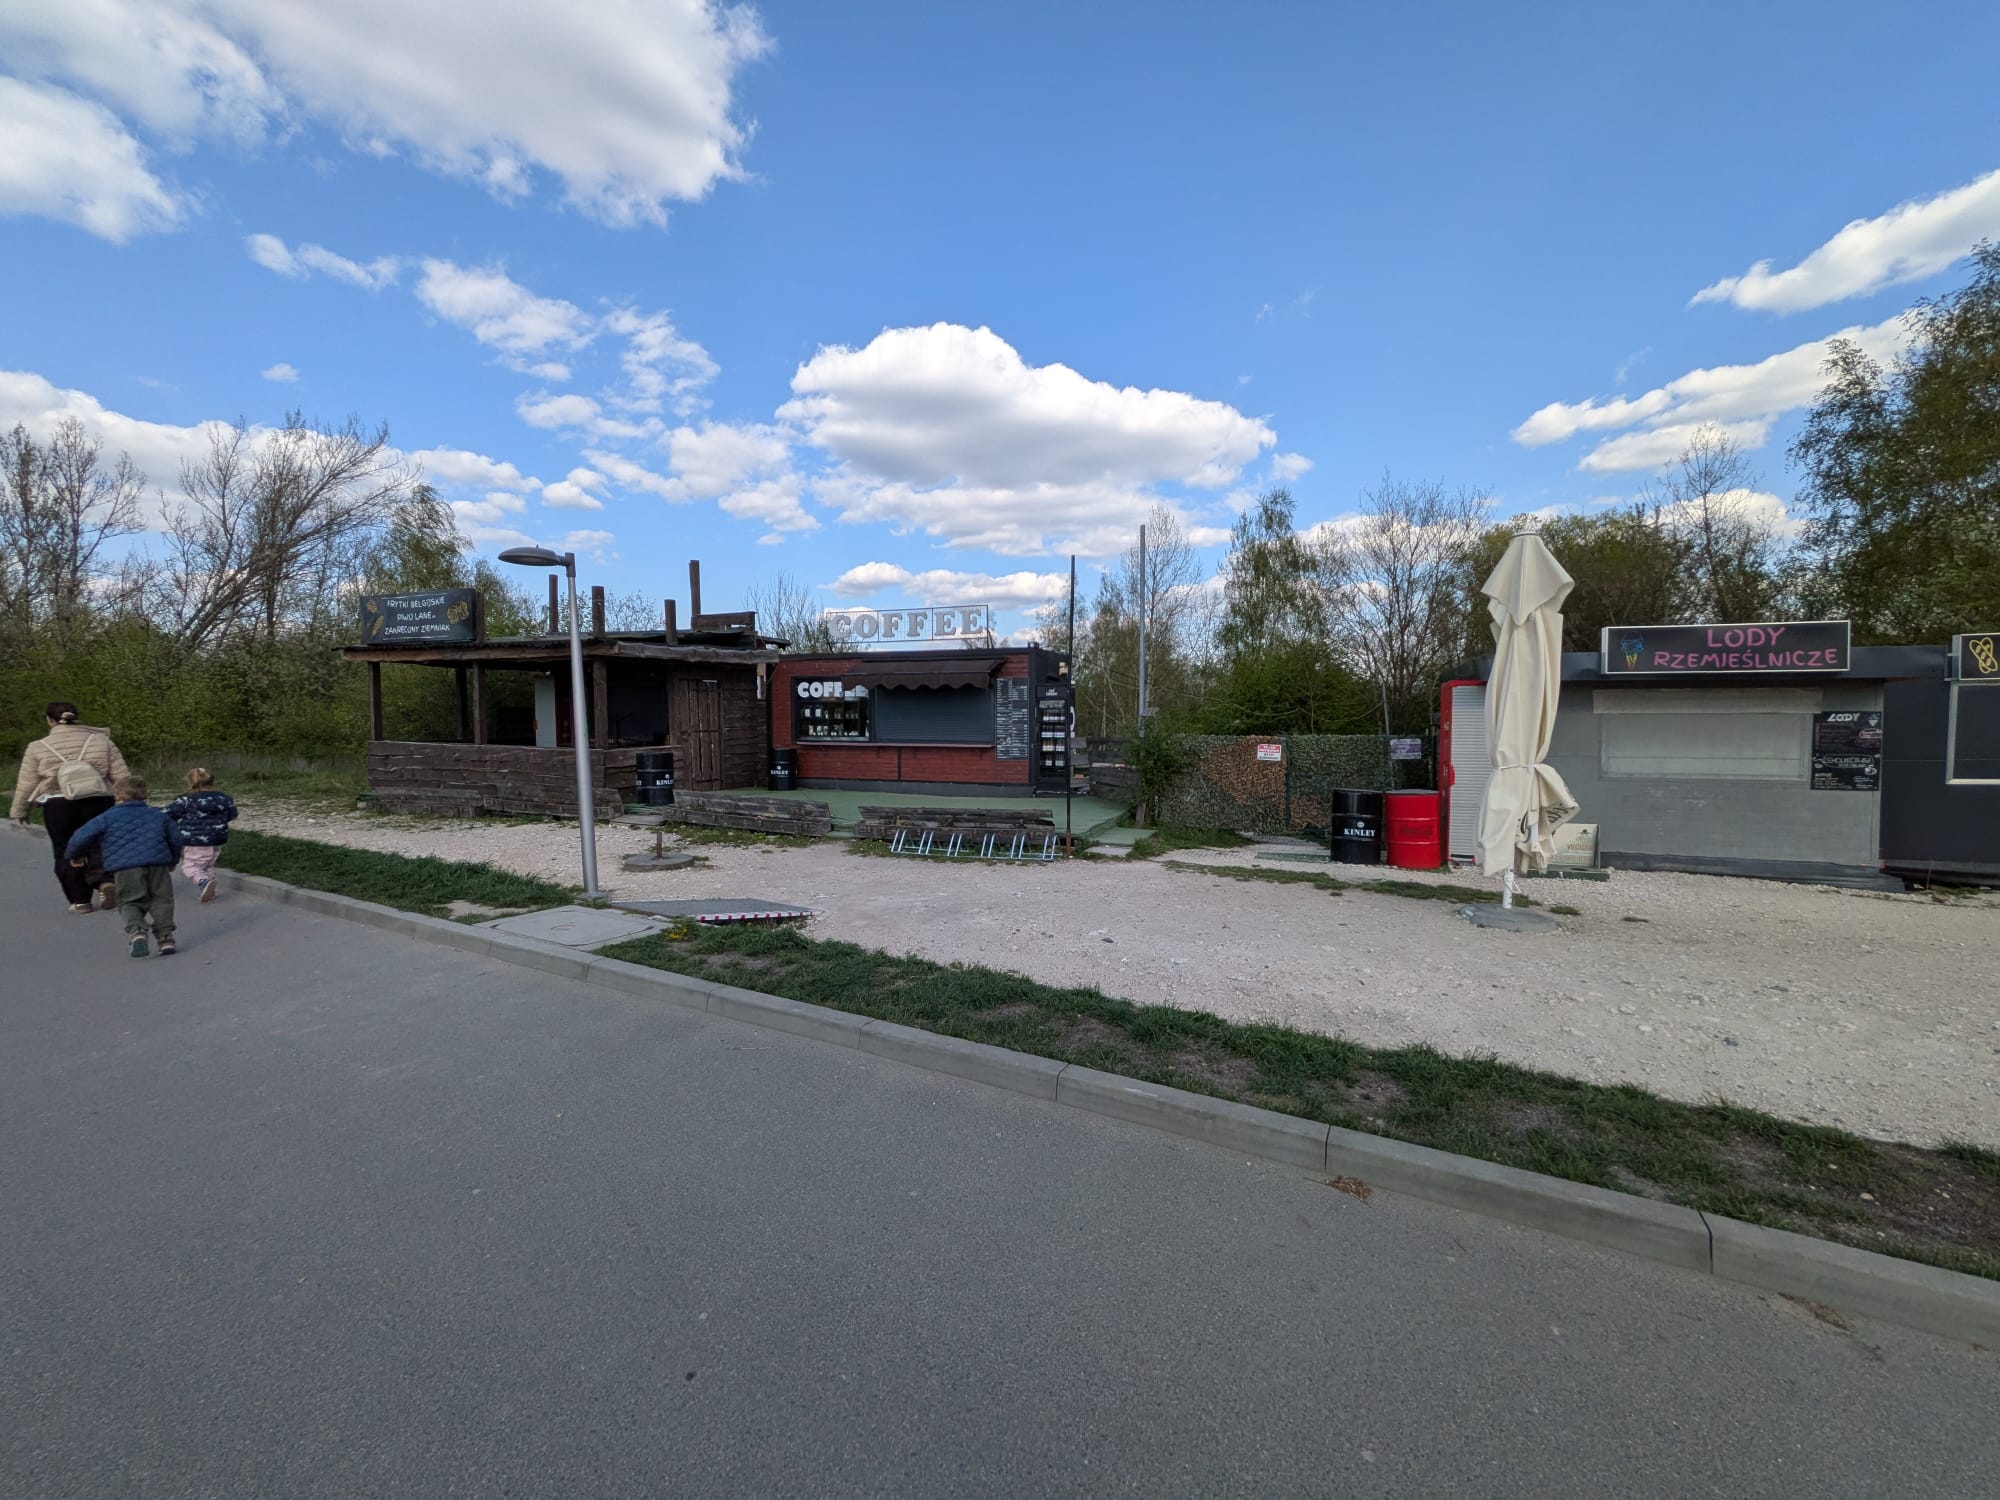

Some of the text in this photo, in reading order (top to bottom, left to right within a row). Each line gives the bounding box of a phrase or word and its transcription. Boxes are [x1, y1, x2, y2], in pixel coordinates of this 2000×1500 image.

[387, 600, 409, 608] FRYTKI
[828, 608, 984, 639] COFFEE
[1707, 627, 1787, 648] LODY
[1653, 648, 1838, 669] RZEMIEŚLNICZE
[1827, 712, 1860, 722] LODY
[1343, 828, 1376, 837] KINLEY
